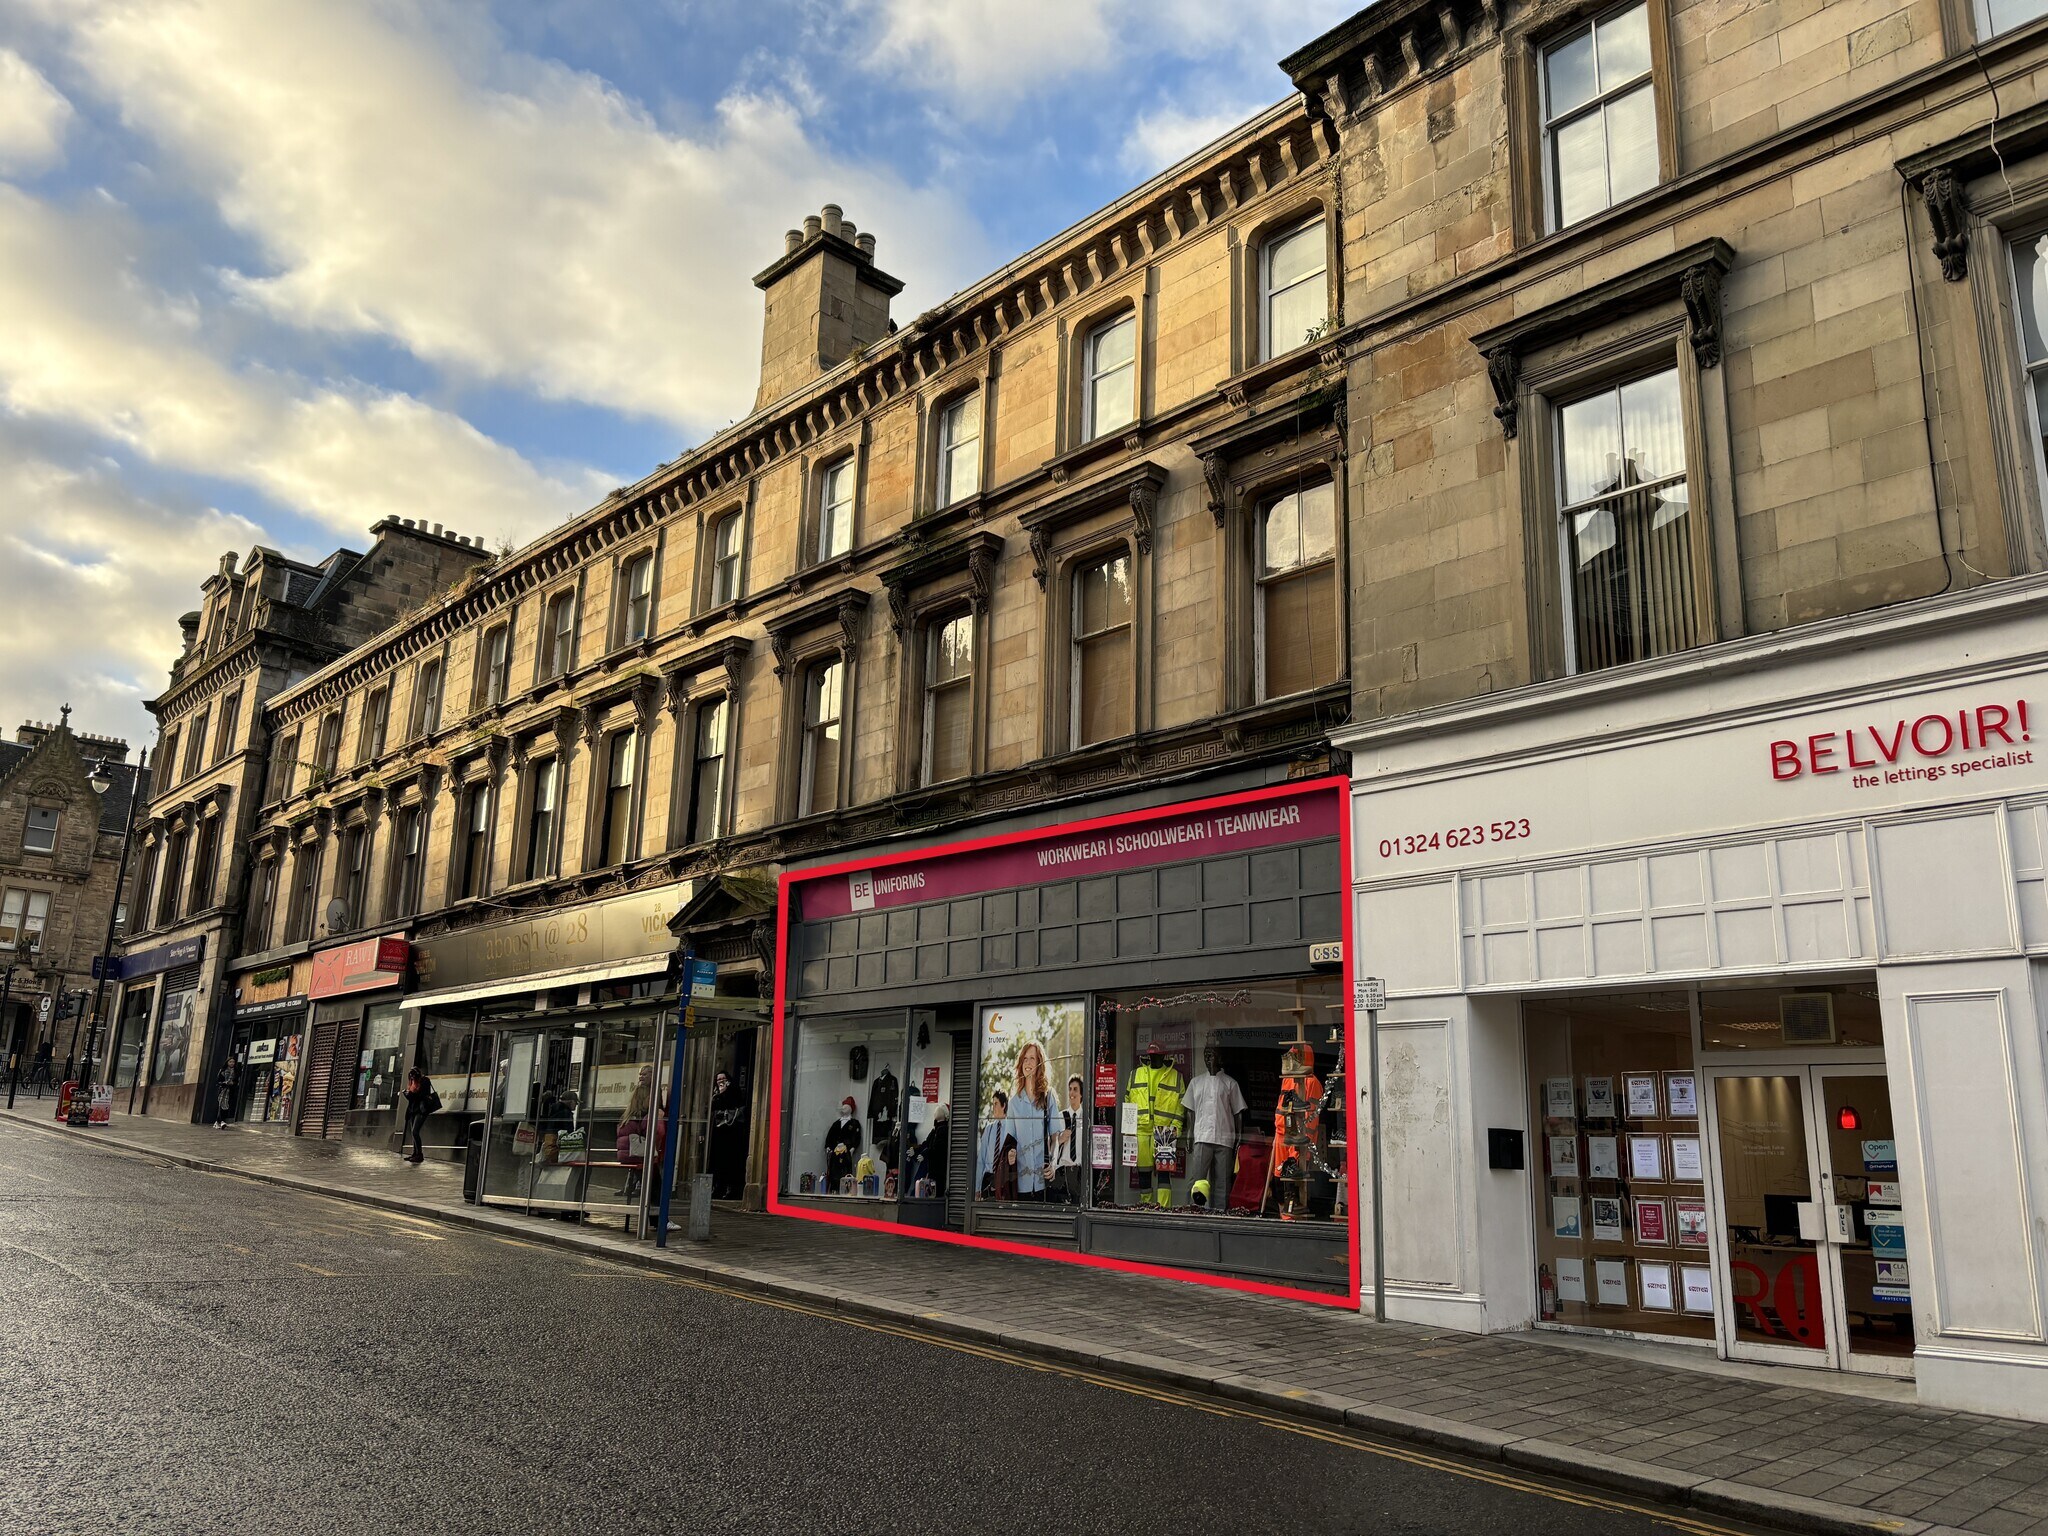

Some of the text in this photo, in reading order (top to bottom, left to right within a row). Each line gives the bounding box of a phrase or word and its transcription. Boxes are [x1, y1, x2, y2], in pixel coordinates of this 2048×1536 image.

[1769, 699, 2032, 781] BELVOIR!
[1853, 750, 2034, 788] the lettings specialist
[1037, 839, 1107, 867] WORKWEAR
[1116, 823, 1204, 854] SCHOOLWEAR
[1215, 804, 1301, 837] TEAMWEAR
[1379, 818, 1532, 858] 01324 623 523
[854, 872, 926, 899] BE UNIFORMS
[654, 903, 662, 913] 28
[544, 920, 561, 952] @
[566, 912, 588, 945] 28
[1154, 1031, 1186, 1042] UNIFORMS
[561, 1132, 584, 1141] ASDA
